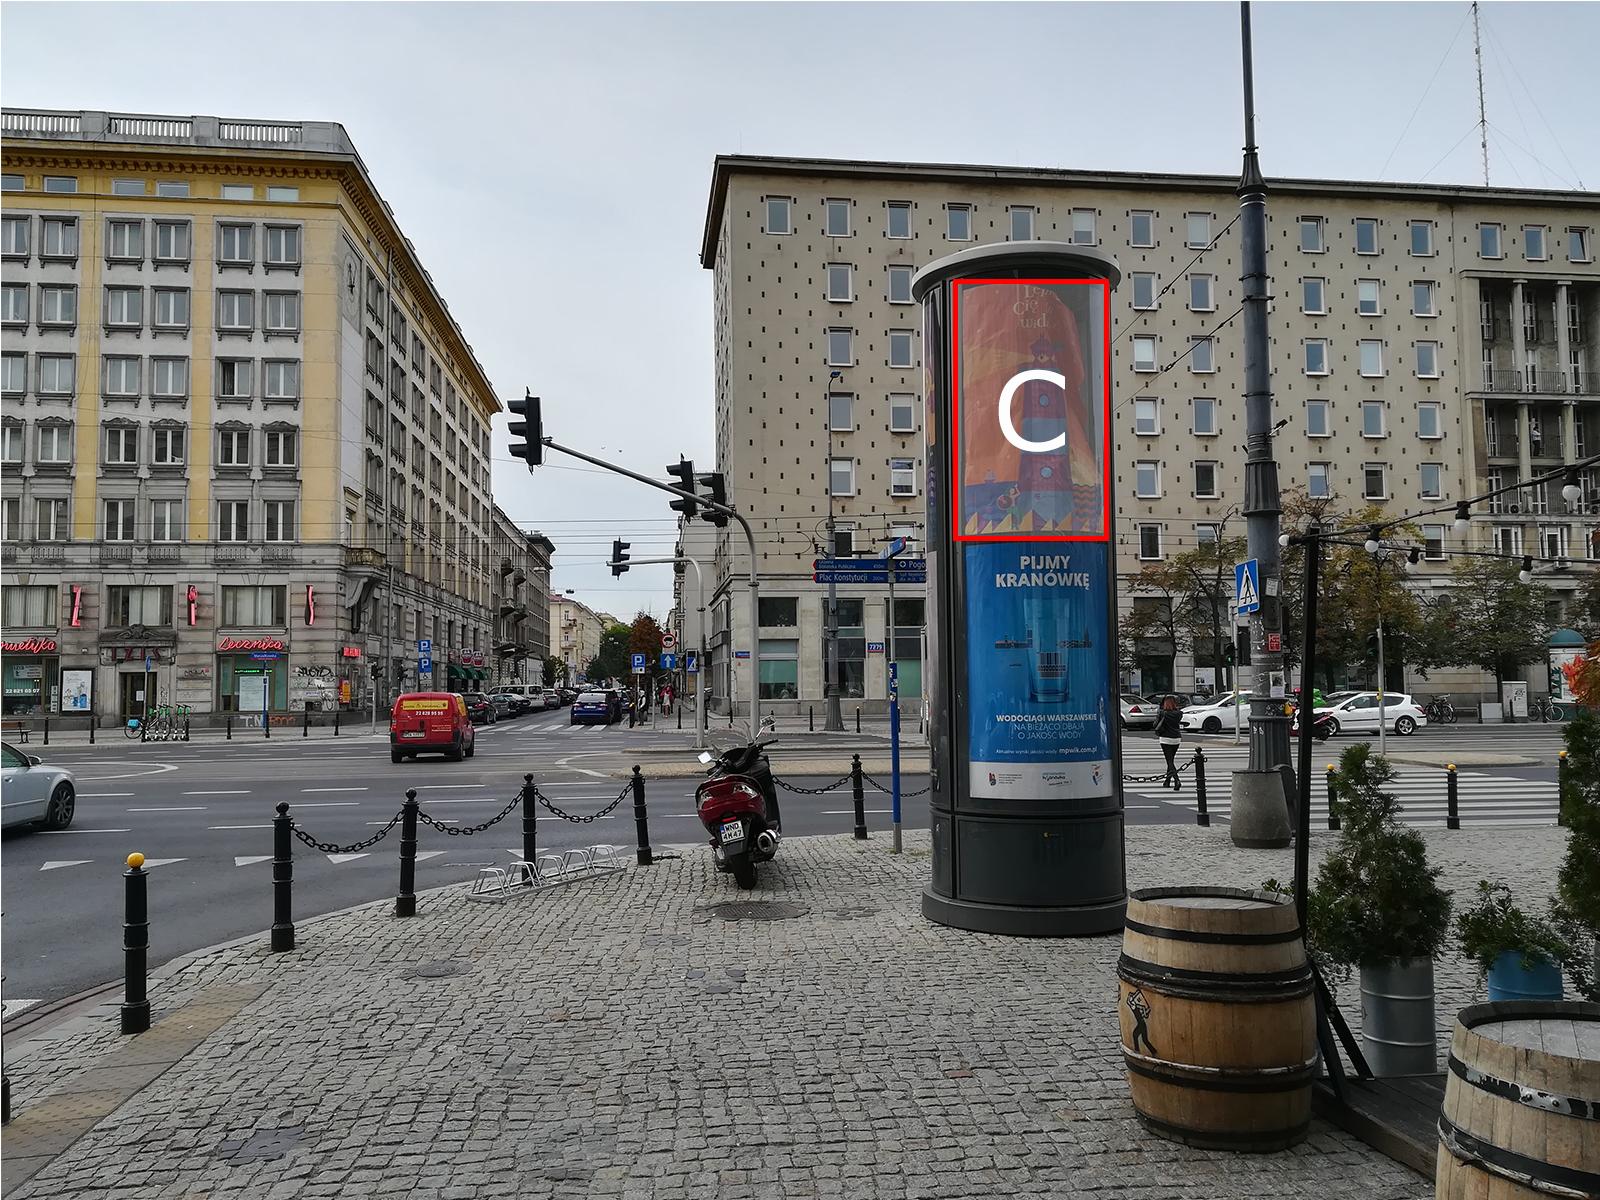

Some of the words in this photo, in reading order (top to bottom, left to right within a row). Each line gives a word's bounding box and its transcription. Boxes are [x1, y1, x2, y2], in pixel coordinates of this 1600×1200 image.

[1020, 555, 1070, 570] PIJMY
[818, 573, 833, 581] Plac
[833, 573, 868, 582] Konstytucji
[995, 570, 1090, 590] KRANÓWKĘ
[218, 634, 283, 650] Lecznica
[634, 655, 643, 666] P
[995, 714, 1046, 723] WODOCIĄGI
[1046, 713, 1097, 722] WARSZAWSKIE
[1014, 723, 1027, 731] NA
[1027, 722, 1061, 731] BIEŻĄCO
[1062, 722, 1085, 731] DBAJĄ
[1017, 732, 1025, 740] O
[1026, 731, 1058, 740] JAKOŚĆ
[1058, 731, 1081, 739] WODY
[1059, 746, 1097, 755] mpwik.com.pl
[724, 822, 740, 831] WND
